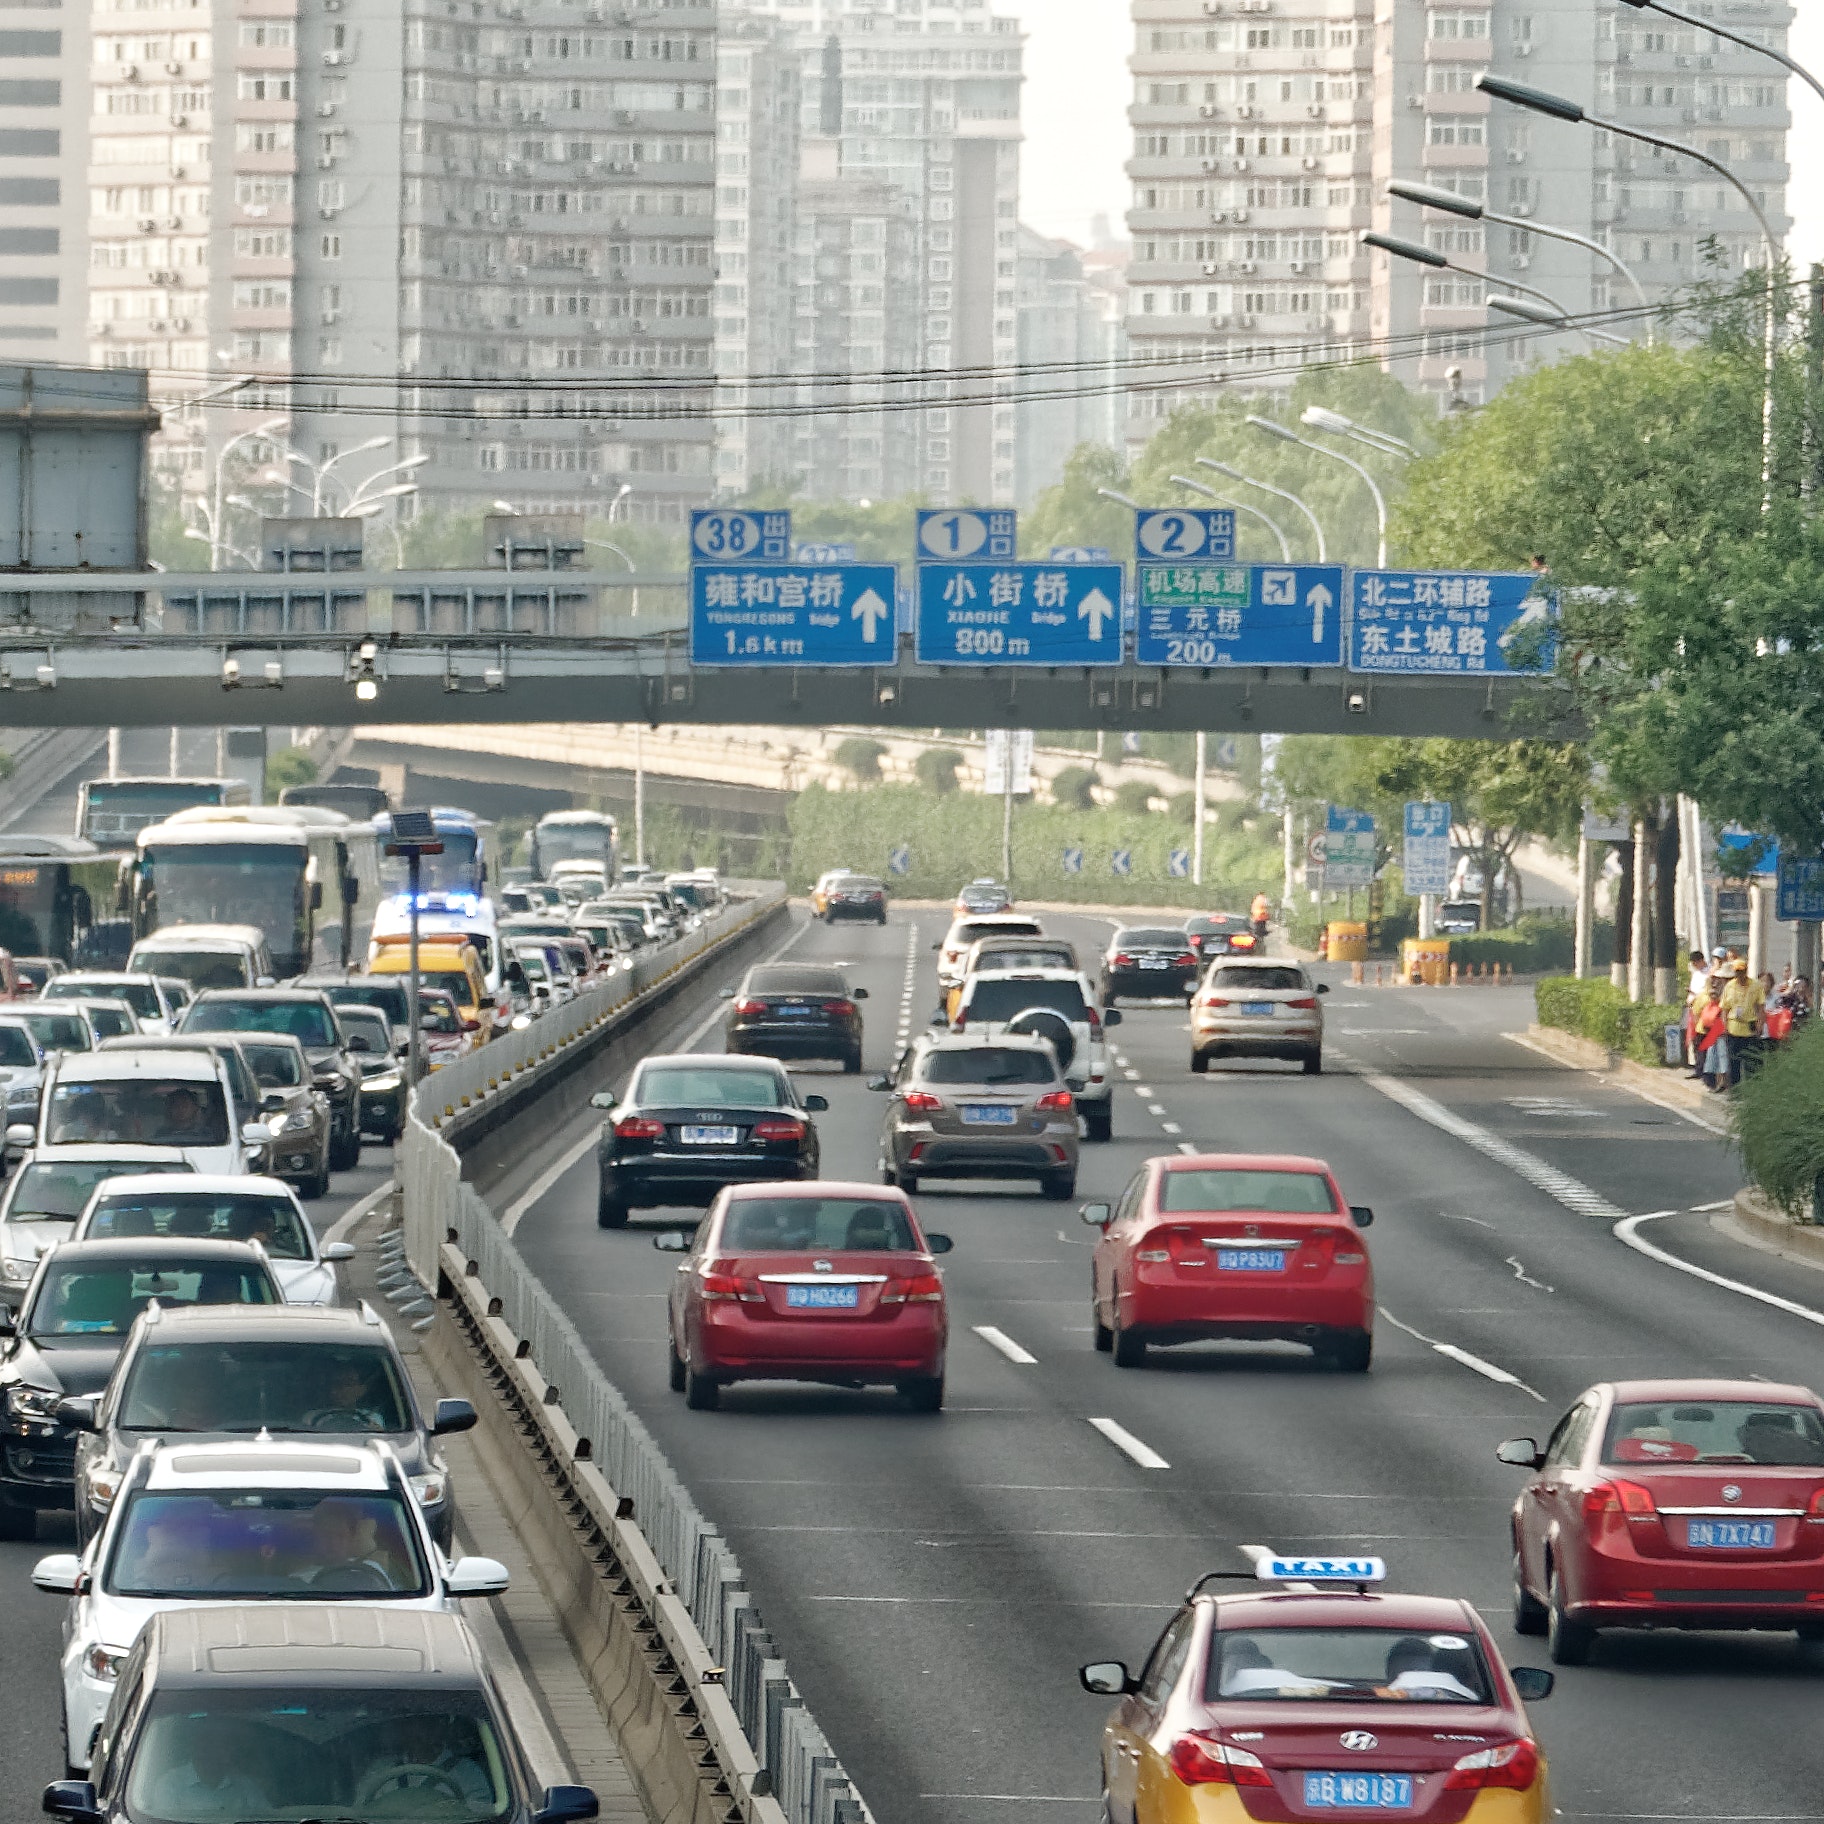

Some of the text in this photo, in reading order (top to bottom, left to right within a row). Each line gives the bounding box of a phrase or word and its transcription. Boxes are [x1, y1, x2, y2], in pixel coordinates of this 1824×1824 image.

[707, 517, 746, 551] 38
[762, 514, 787, 557] 出口
[942, 516, 960, 552] 1
[988, 513, 1013, 556] 出口
[1160, 517, 1186, 553] 2
[1208, 513, 1232, 556] 出口
[705, 572, 844, 608] 雍和宫桥
[942, 571, 1069, 608] 小街桥
[1149, 568, 1246, 594] 机场高速
[1361, 576, 1491, 608] 北二环辅路
[1149, 607, 1243, 632] 三元桥
[1360, 624, 1488, 656] 东土城路
[1282, 1559, 1369, 1574] TAXI
